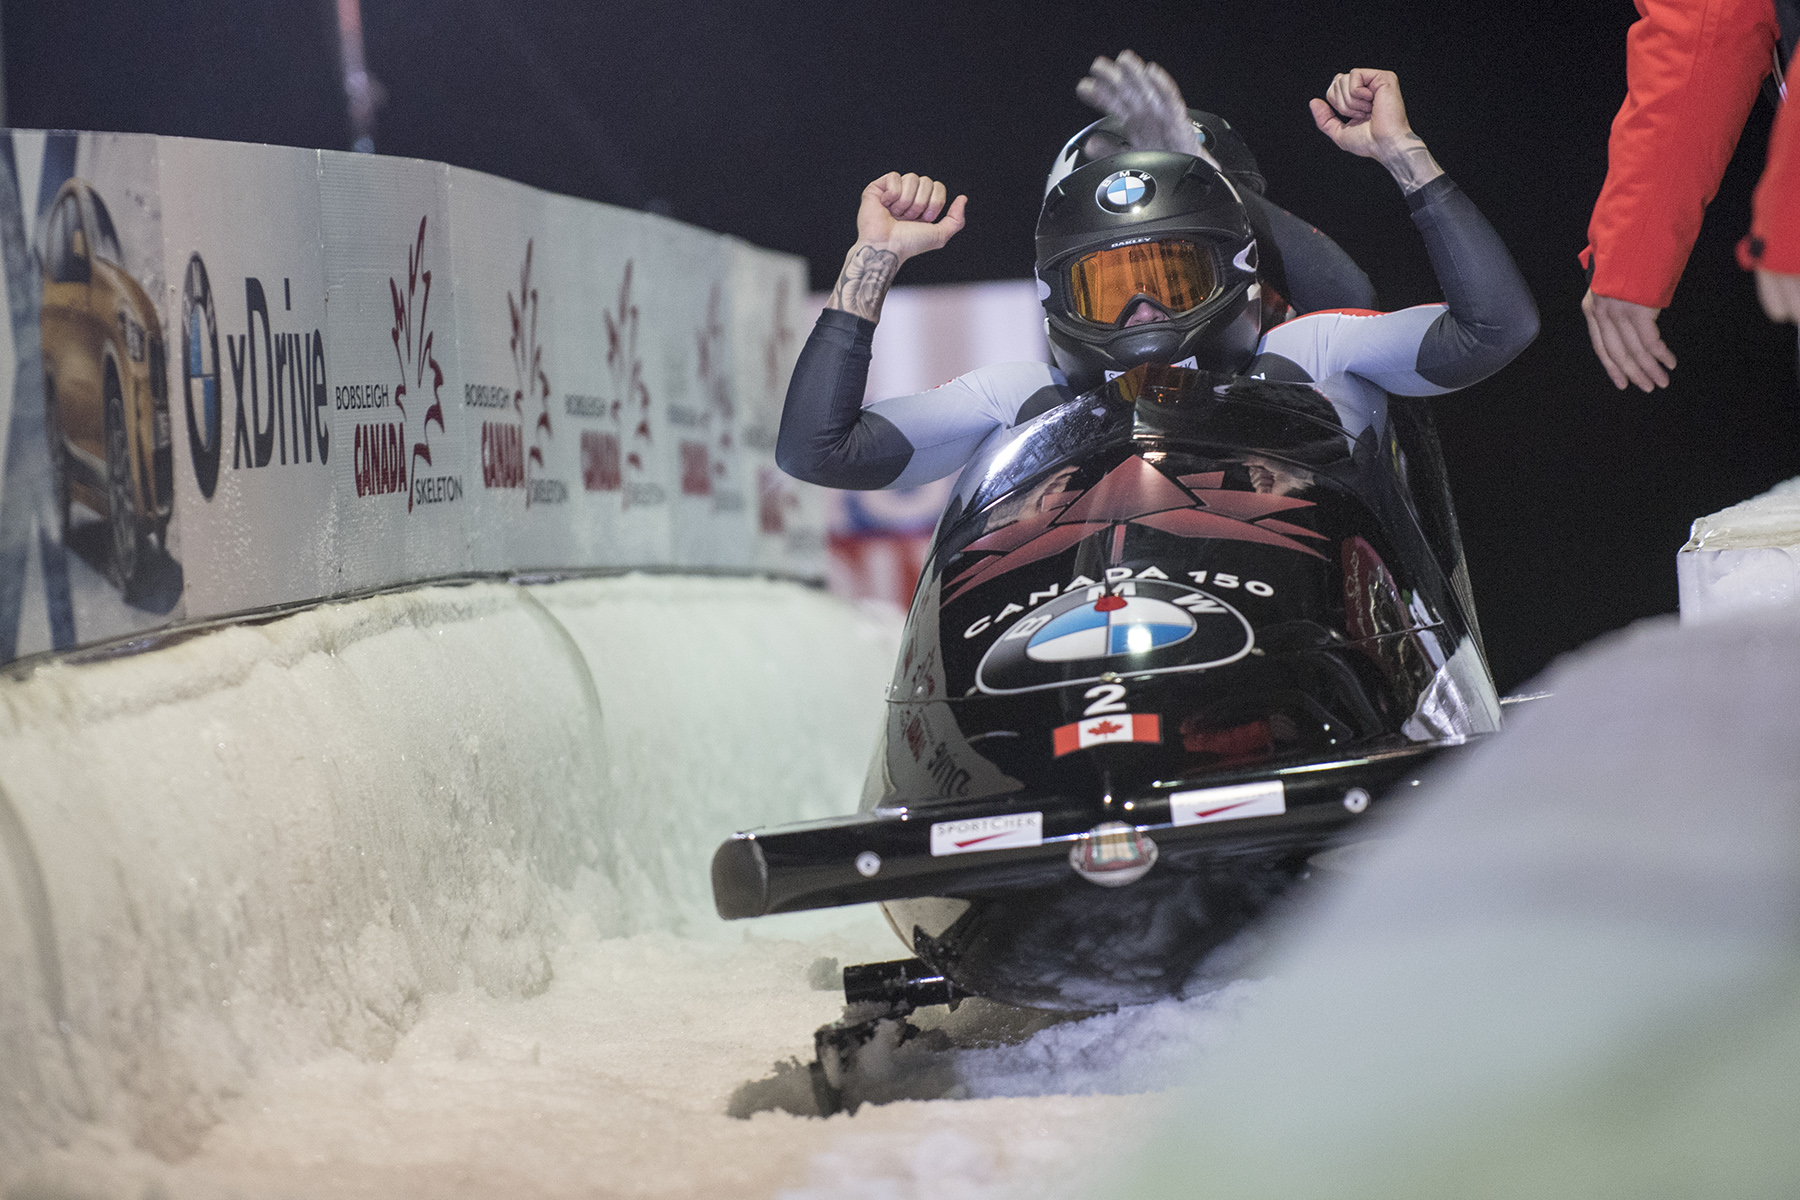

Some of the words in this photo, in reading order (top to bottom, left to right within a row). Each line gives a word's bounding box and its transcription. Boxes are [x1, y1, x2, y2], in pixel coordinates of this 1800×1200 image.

[1101, 170, 1151, 188] BMW
[1111, 237, 1152, 248] OAKLEY
[227, 277, 329, 470] xDrive
[335, 384, 390, 410] BOBSLEIGH
[354, 422, 407, 498] CANADA
[415, 475, 463, 505] SKELETON
[963, 566, 1169, 639] CANADA
[1187, 570, 1275, 597] 150
[1003, 582, 1228, 641] BMW
[1083, 684, 1127, 716] 2
